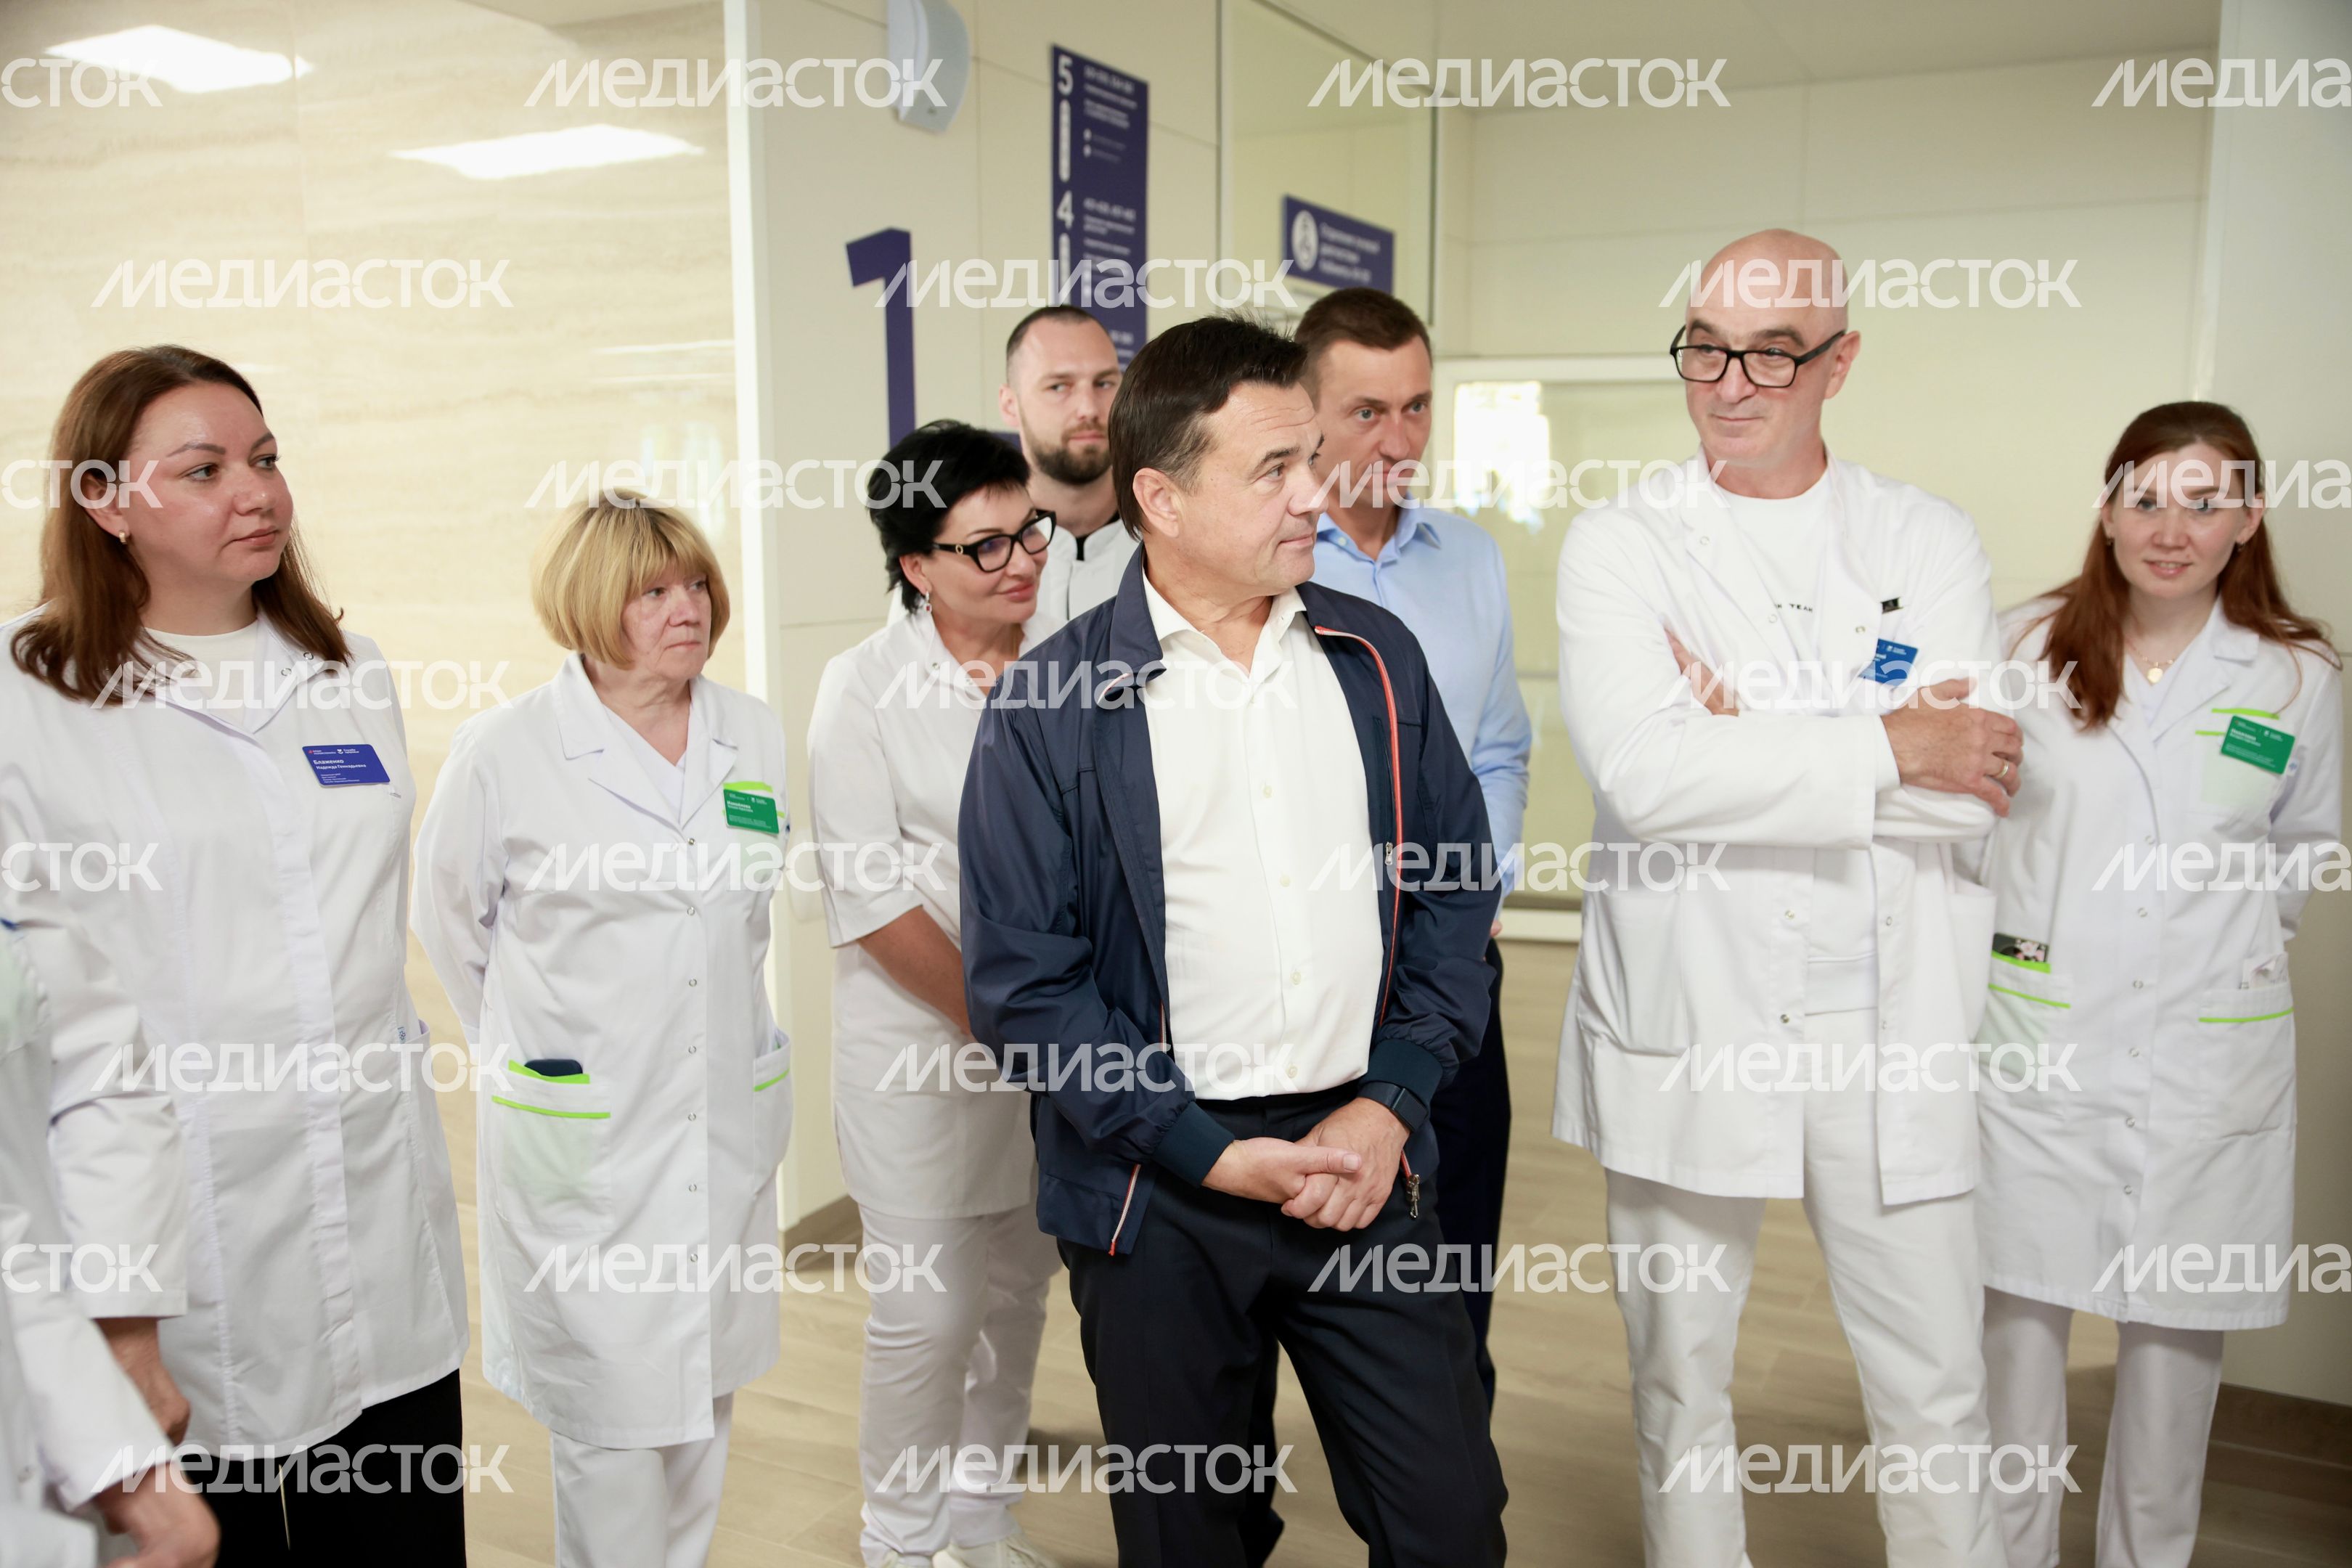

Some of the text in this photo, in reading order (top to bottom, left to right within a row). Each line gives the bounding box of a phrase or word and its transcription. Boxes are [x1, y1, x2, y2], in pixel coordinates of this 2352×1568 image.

[1057, 54, 1074, 96] 5
[1056, 189, 1074, 230] 4
[846, 226, 916, 452] 1
